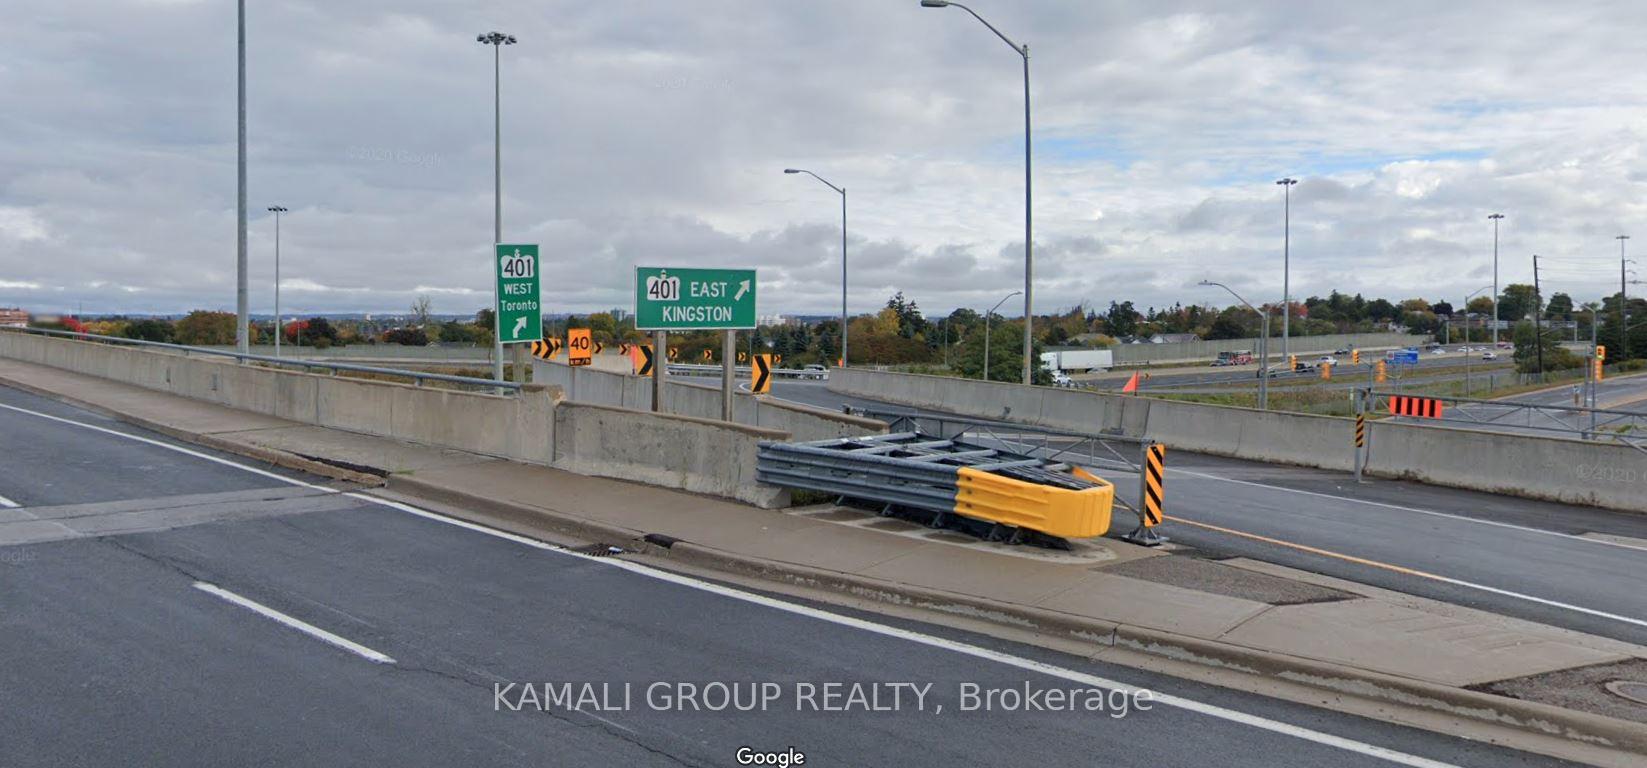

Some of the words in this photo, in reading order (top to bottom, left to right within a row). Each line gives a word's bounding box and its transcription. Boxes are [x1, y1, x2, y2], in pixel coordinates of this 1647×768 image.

[504, 258, 531, 277] 401
[504, 283, 533, 295] WEST
[649, 280, 677, 299] 401
[691, 282, 727, 298] EAST
[501, 300, 538, 311] Toronto
[663, 306, 732, 322] KINGSTON
[571, 336, 589, 350] 40
